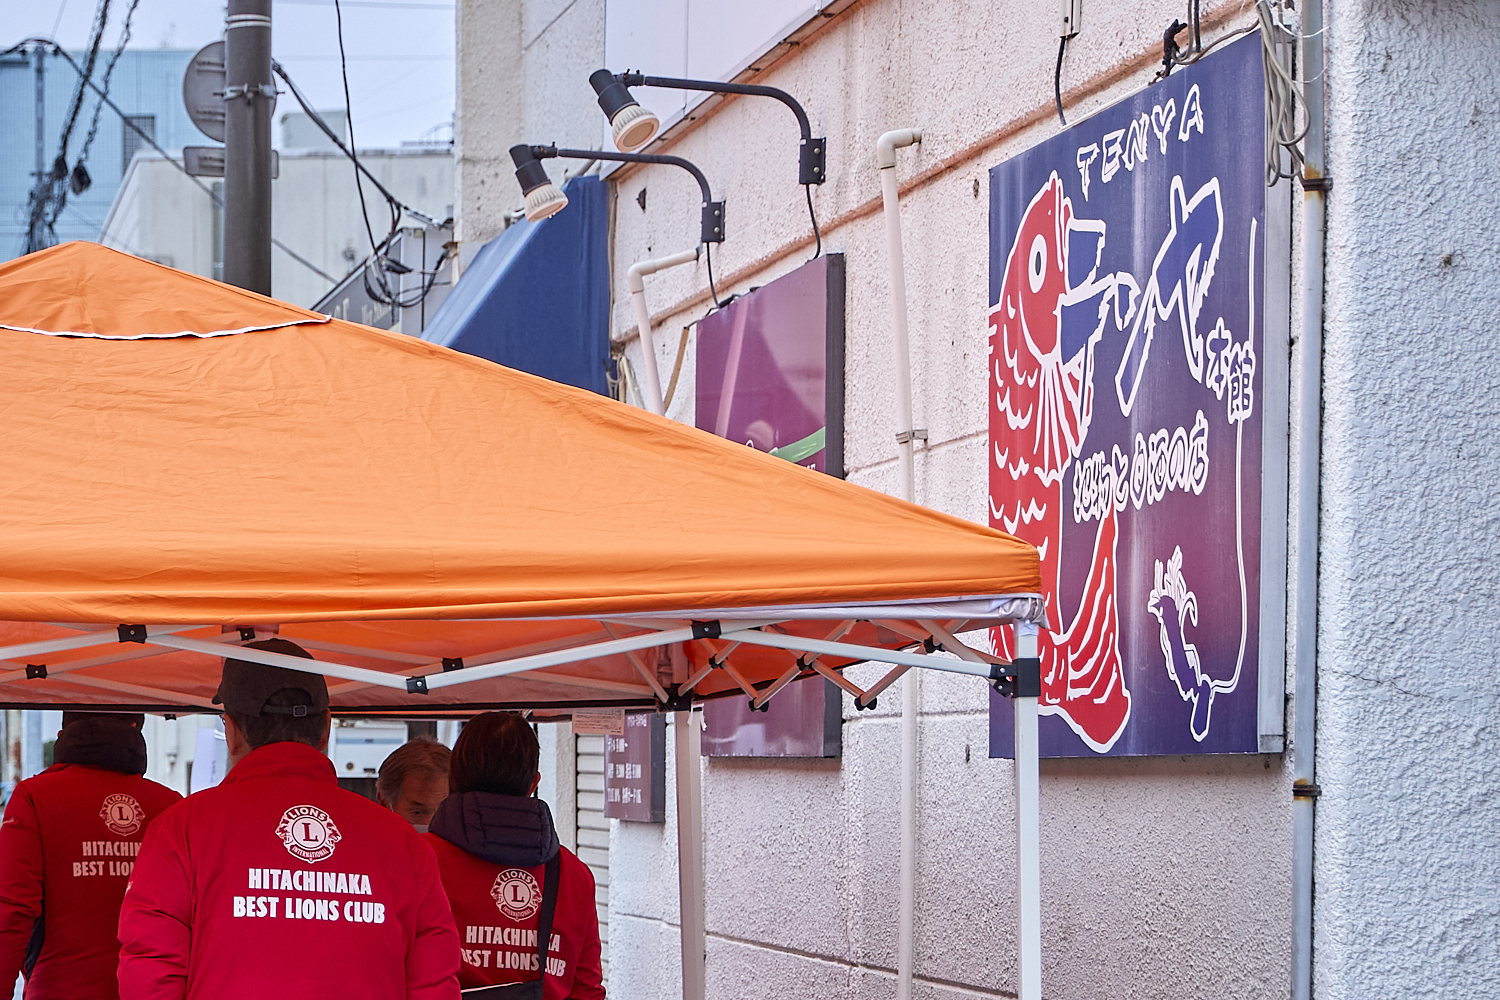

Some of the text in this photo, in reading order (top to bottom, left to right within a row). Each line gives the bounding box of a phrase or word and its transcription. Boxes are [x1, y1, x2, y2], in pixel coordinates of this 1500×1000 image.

[1076, 83, 1205, 202] TENYA
[1205, 316, 1256, 425] 本館
[287, 806, 327, 822] LIONS
[301, 822, 320, 843] L
[82, 841, 142, 857] HITACHIN
[72, 861, 105, 877] BEST
[500, 870, 533, 884] LIONS
[248, 868, 373, 896] HITACHINAKA
[511, 884, 525, 903] L
[232, 895, 386, 924] BEST LIONS CLUB
[496, 950, 540, 971] LIONS
